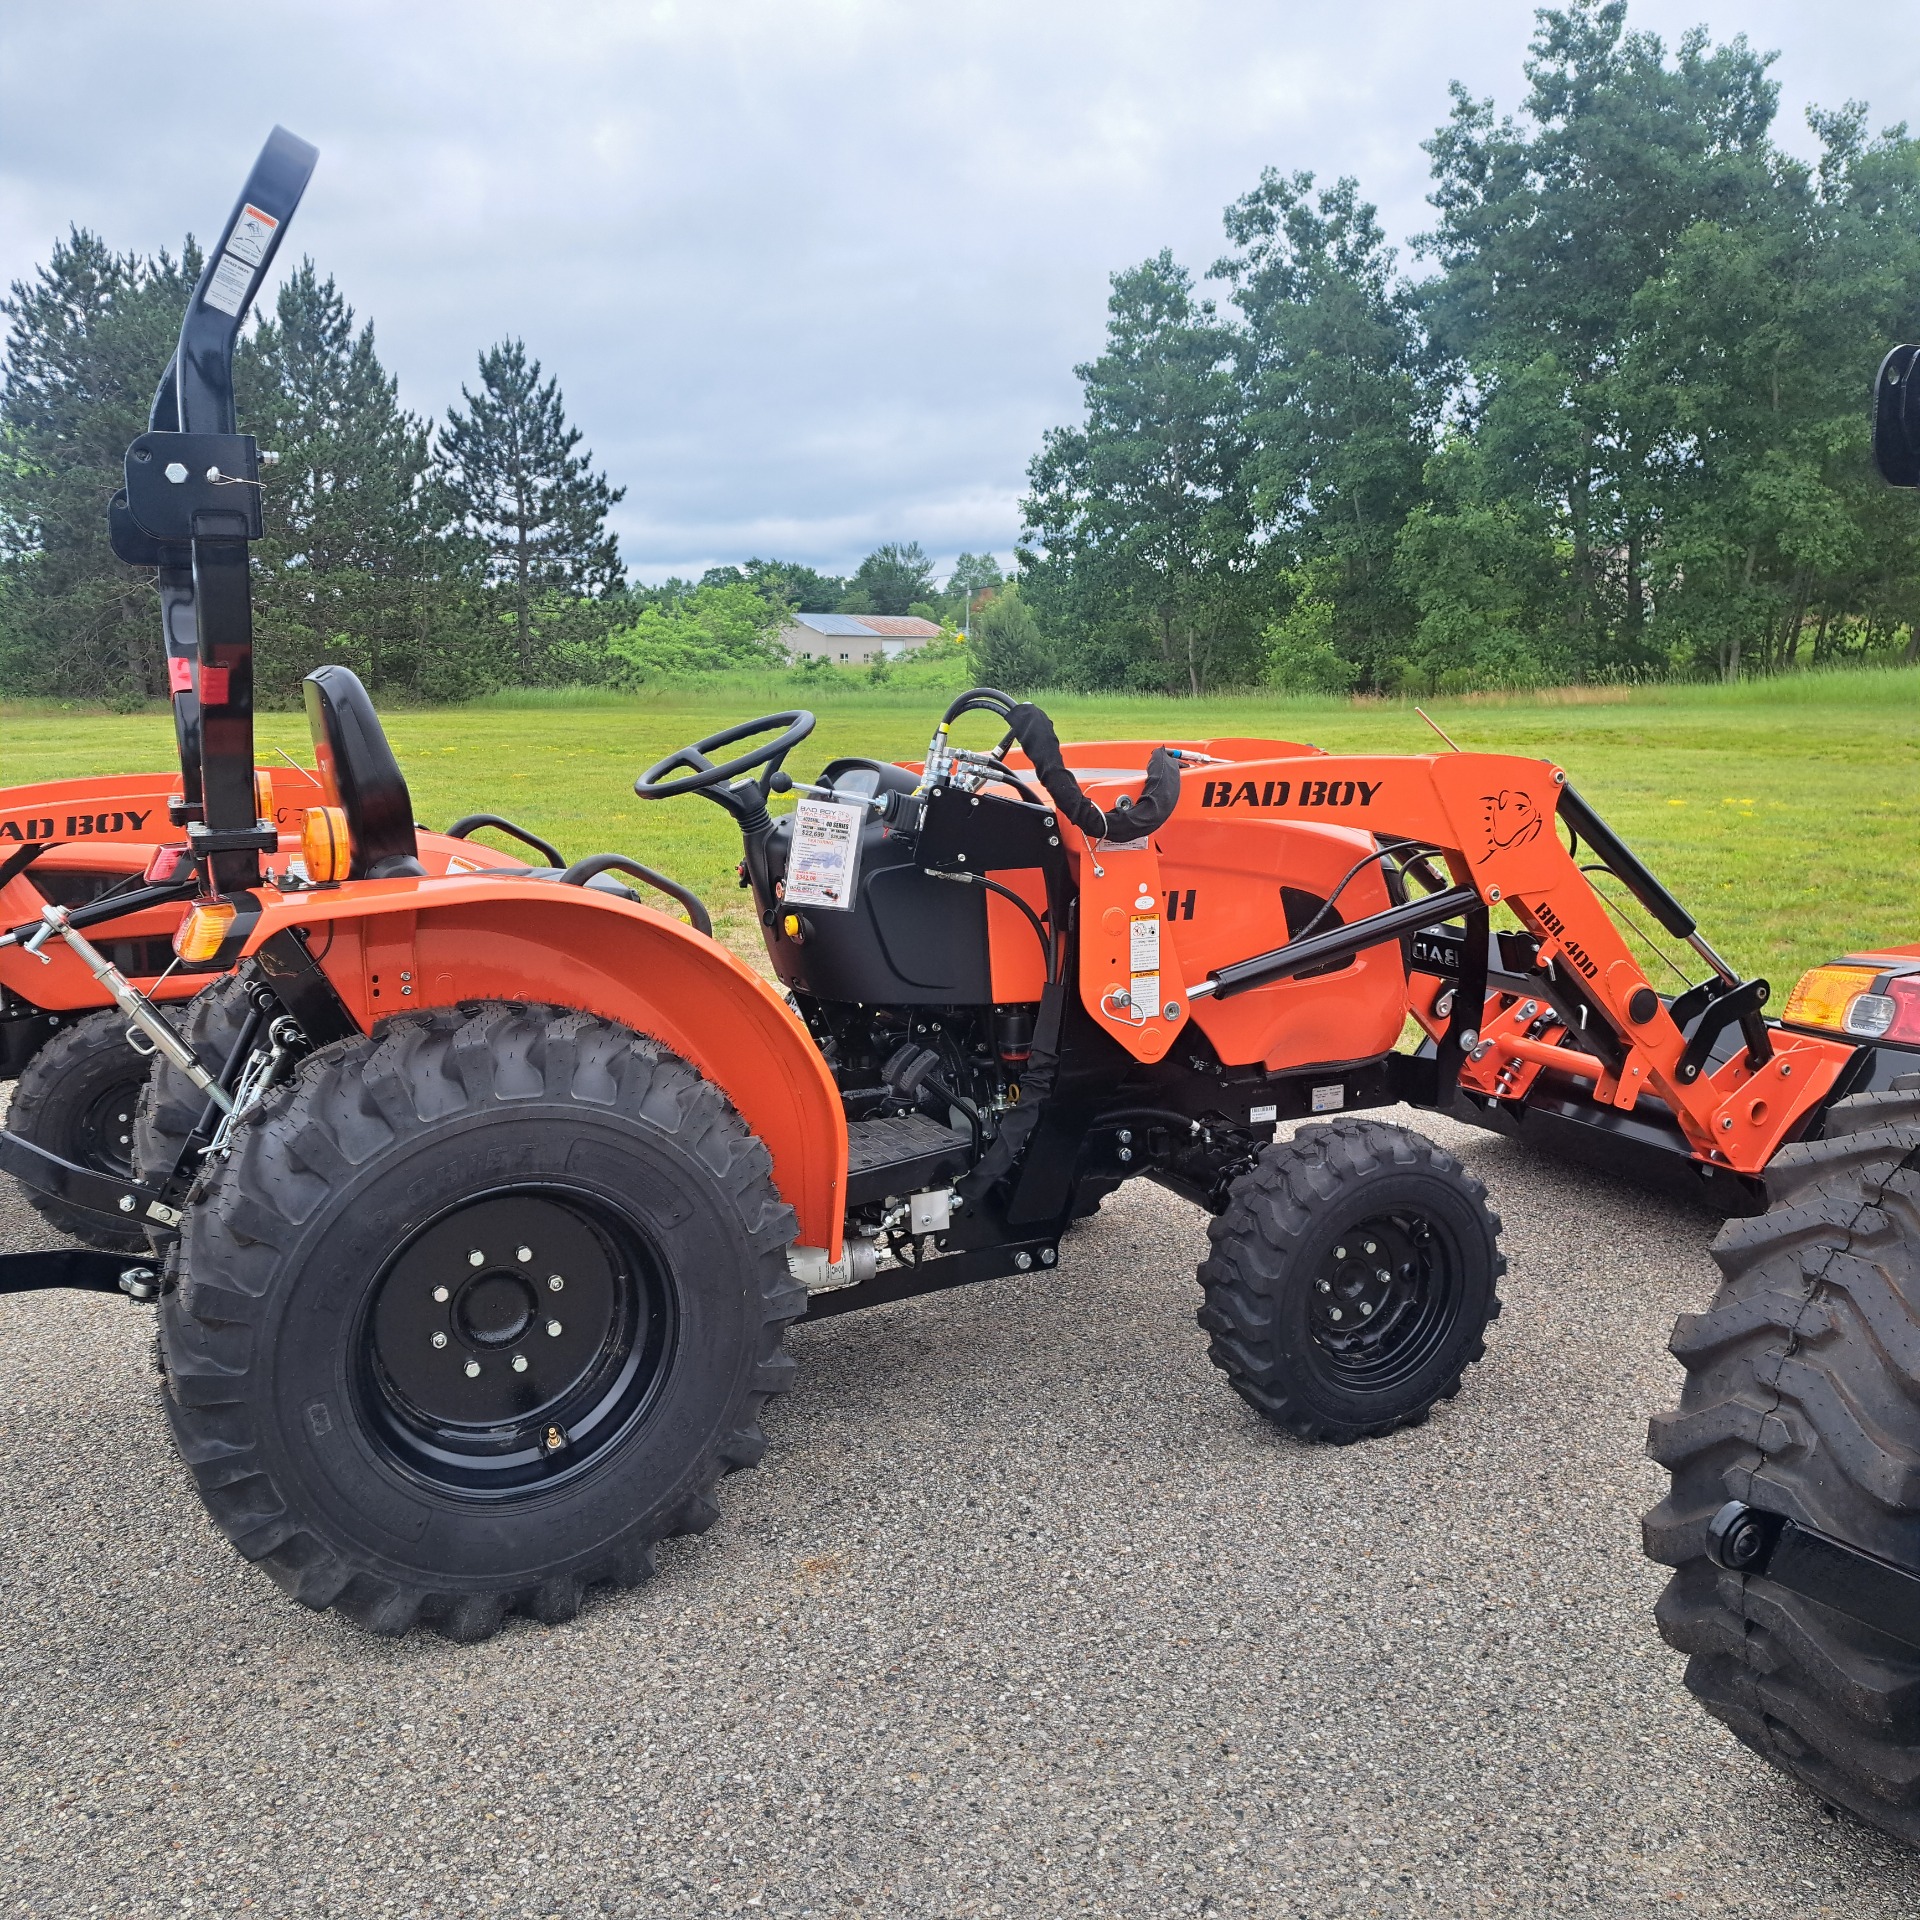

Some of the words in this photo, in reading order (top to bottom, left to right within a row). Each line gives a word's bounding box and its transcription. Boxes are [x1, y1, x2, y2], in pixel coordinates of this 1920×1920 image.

[1201, 782, 1290, 807] BAD
[1299, 781, 1383, 806] BOY
[66, 810, 152, 836] BOY
[833, 822, 849, 830] SERIES
[1534, 902, 1565, 942] BBL
[1564, 941, 1598, 979] 400
